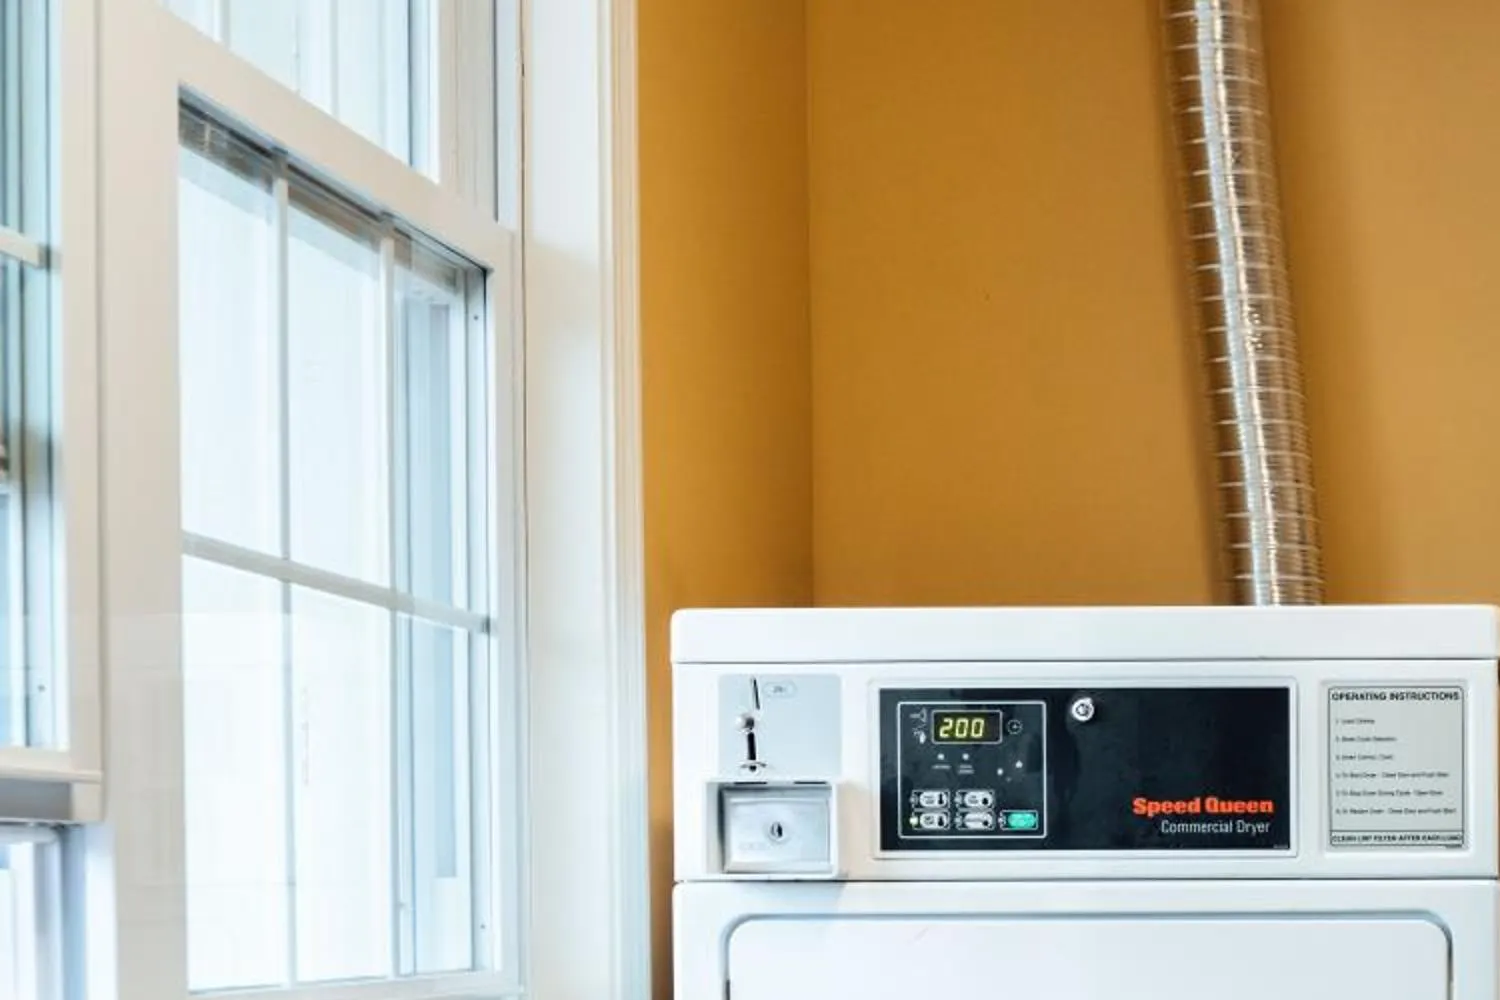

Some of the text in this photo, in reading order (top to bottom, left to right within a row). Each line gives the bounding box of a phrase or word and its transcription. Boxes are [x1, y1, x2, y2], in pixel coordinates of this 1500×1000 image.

[1331, 691, 1460, 701] OPERATING INSTRUCTIONS
[938, 717, 986, 739] 200
[1132, 796, 1274, 817] Speed Queen
[1160, 819, 1271, 836] Commercial Dryer
